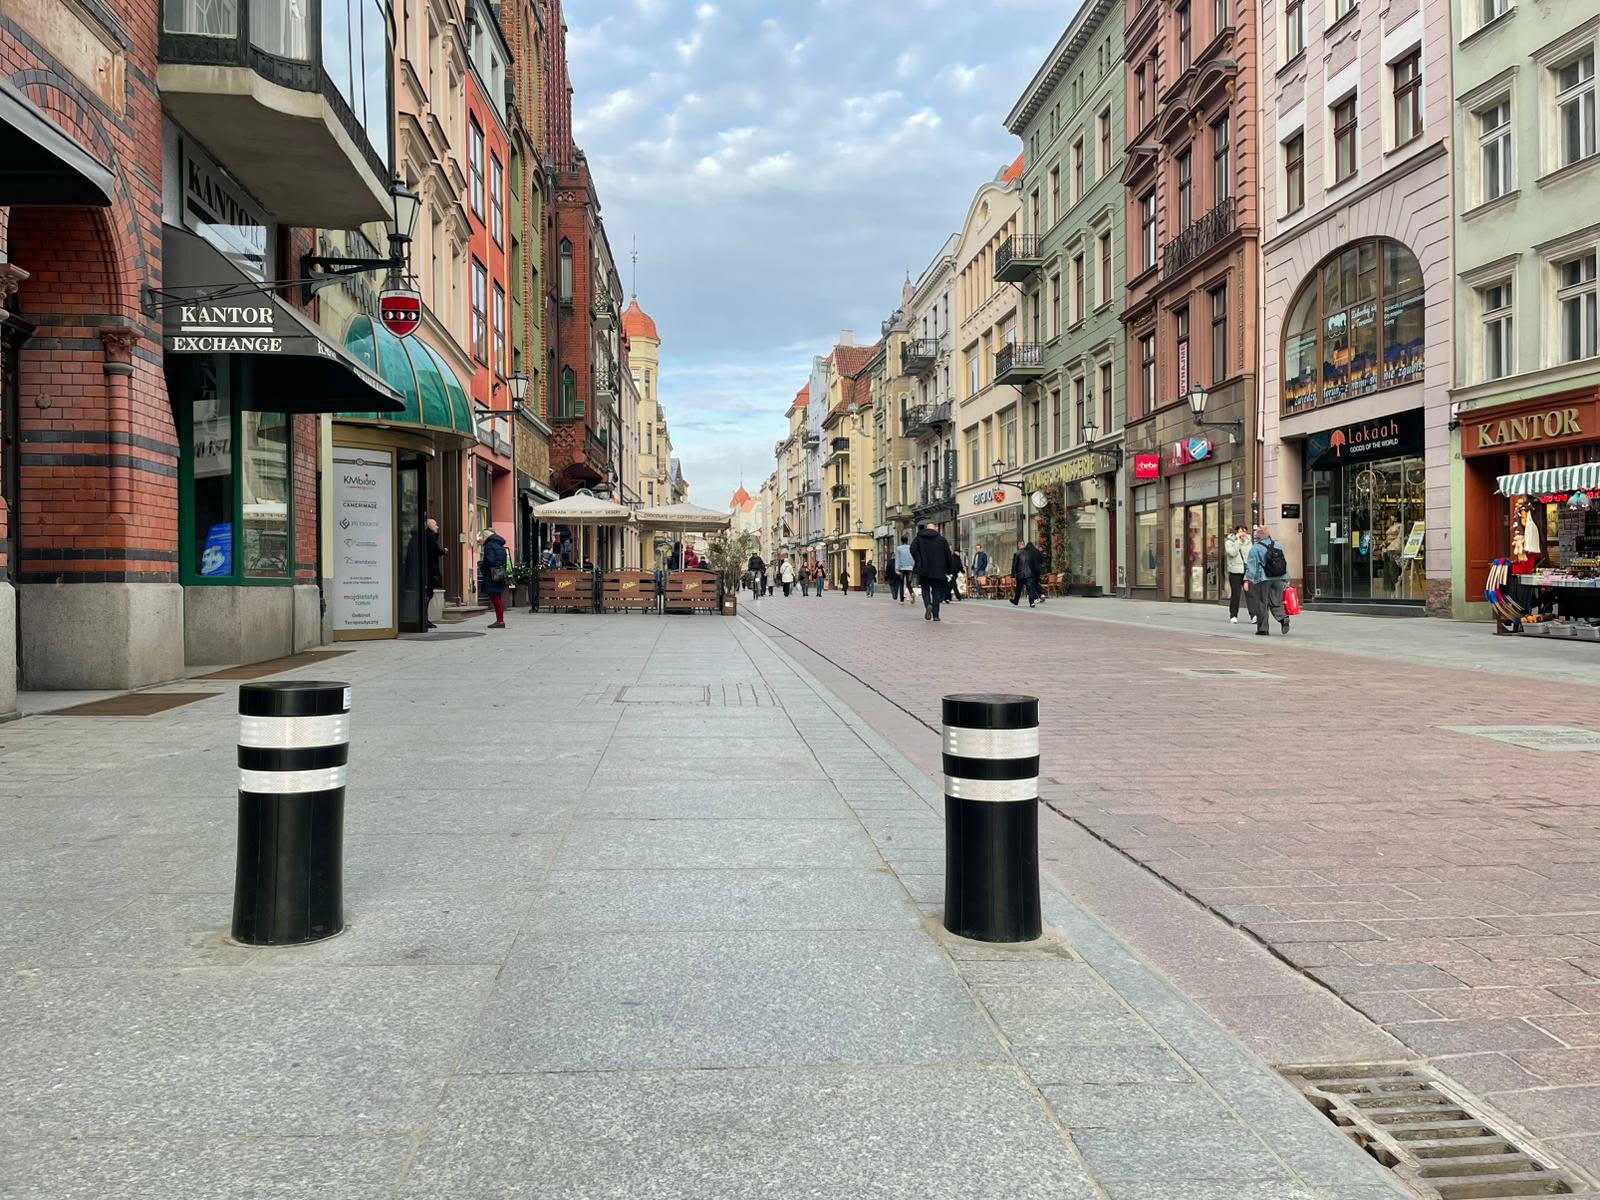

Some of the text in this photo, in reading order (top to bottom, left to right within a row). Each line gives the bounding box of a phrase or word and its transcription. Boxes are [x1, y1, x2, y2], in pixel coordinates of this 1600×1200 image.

[180, 306, 273, 324] KANTOR
[172, 336, 282, 352] EXCHANGE
[1348, 419, 1399, 444] Lokaah
[1477, 408, 1583, 448] KANTOR
[1349, 438, 1399, 454] GOODS OF THE WORLD
